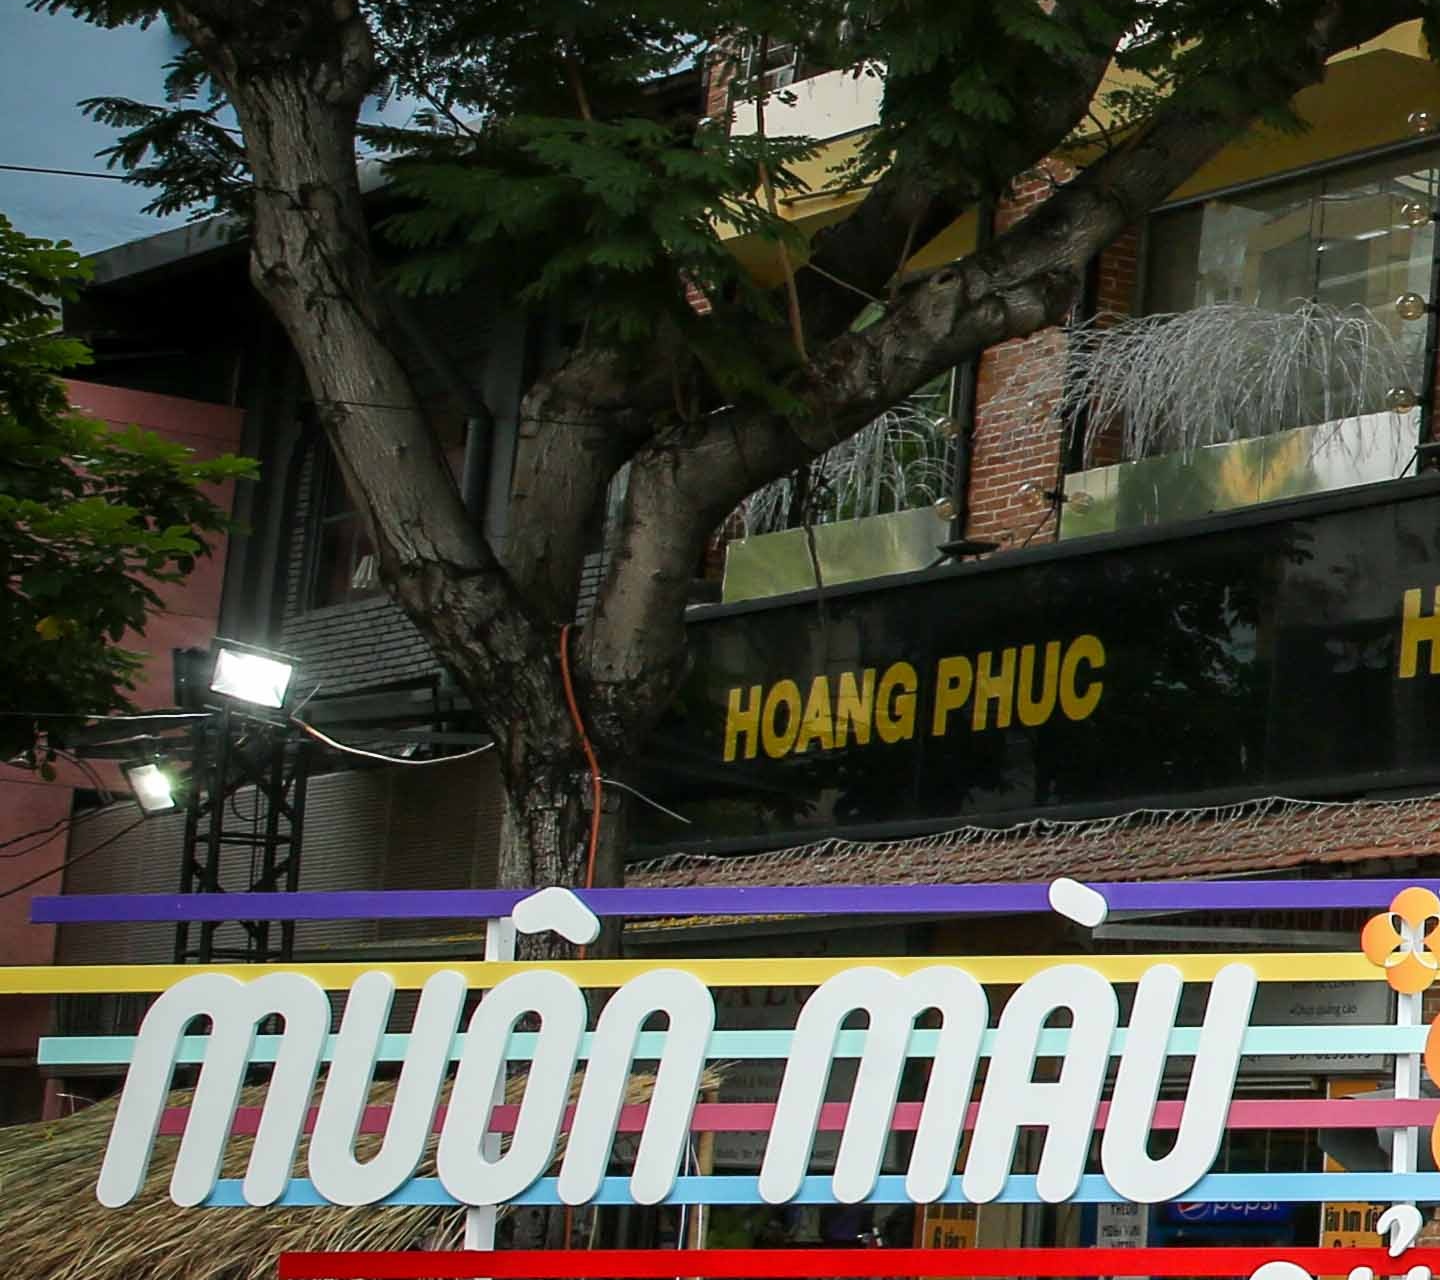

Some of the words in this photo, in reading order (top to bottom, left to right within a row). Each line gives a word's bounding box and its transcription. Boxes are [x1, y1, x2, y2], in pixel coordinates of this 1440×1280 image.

[723, 661, 918, 761] HOANG
[932, 633, 1106, 735] PHUC
[96, 887, 716, 1207] MUÔN
[759, 876, 1257, 1205] MÀU
